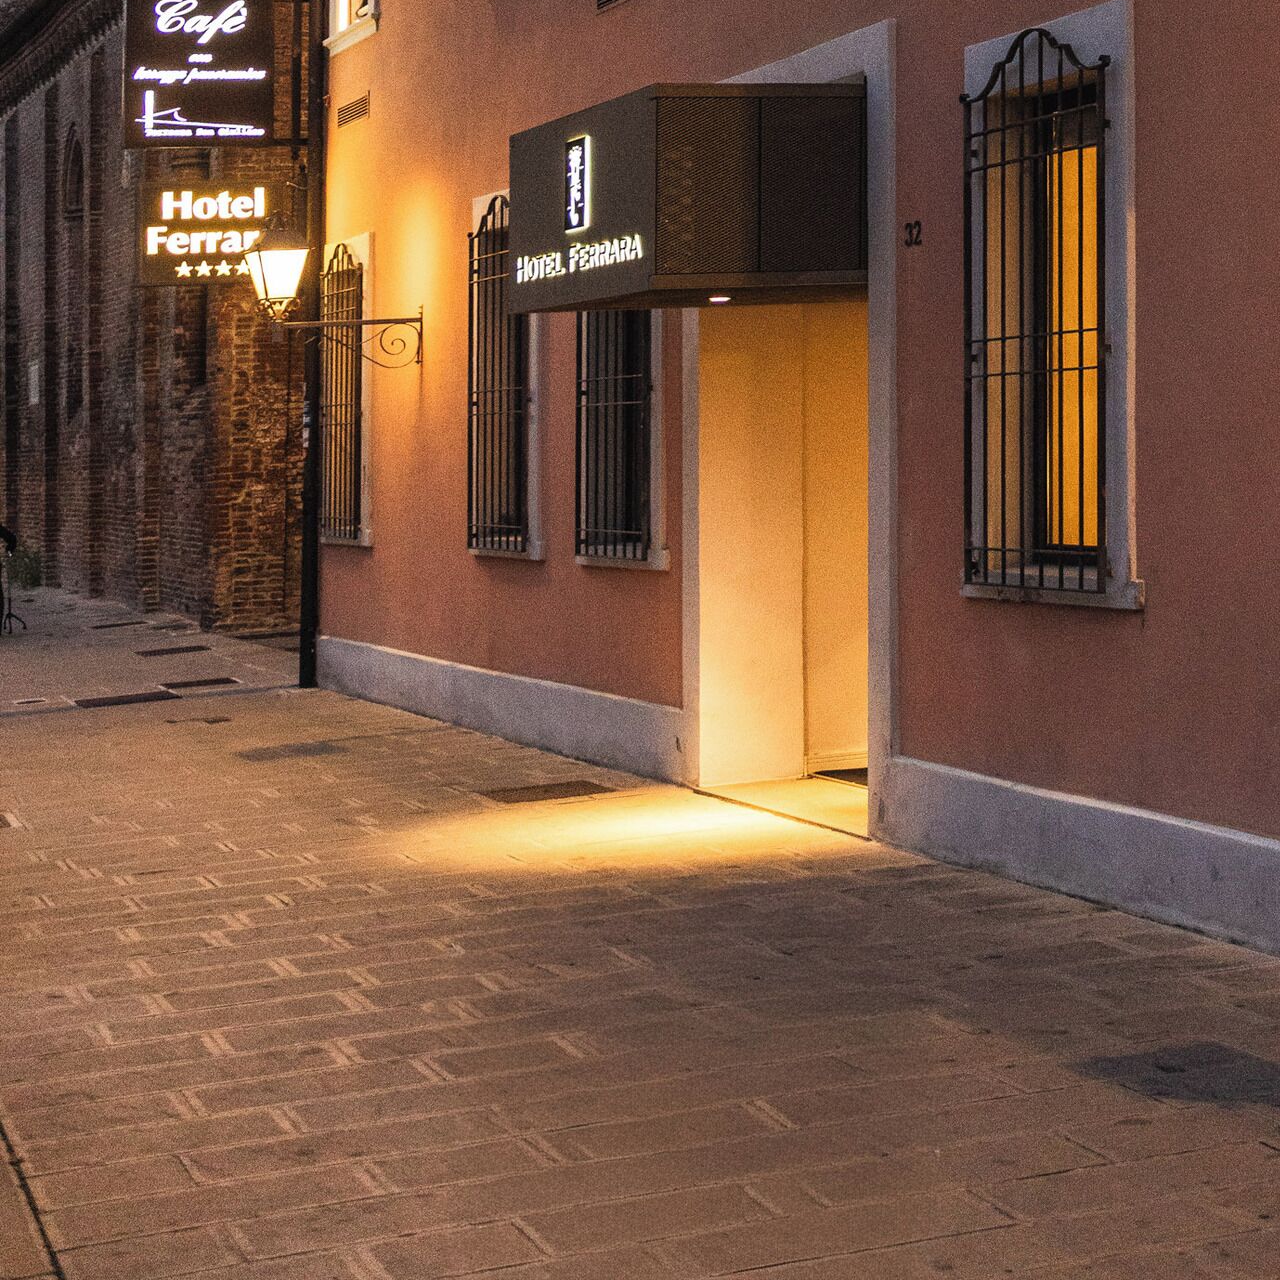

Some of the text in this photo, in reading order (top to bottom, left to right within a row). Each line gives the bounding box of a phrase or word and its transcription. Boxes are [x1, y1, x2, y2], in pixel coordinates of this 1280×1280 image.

[162, 187, 265, 220] Hotel
[146, 226, 261, 256] Ferrar
[905, 220, 922, 247] 32
